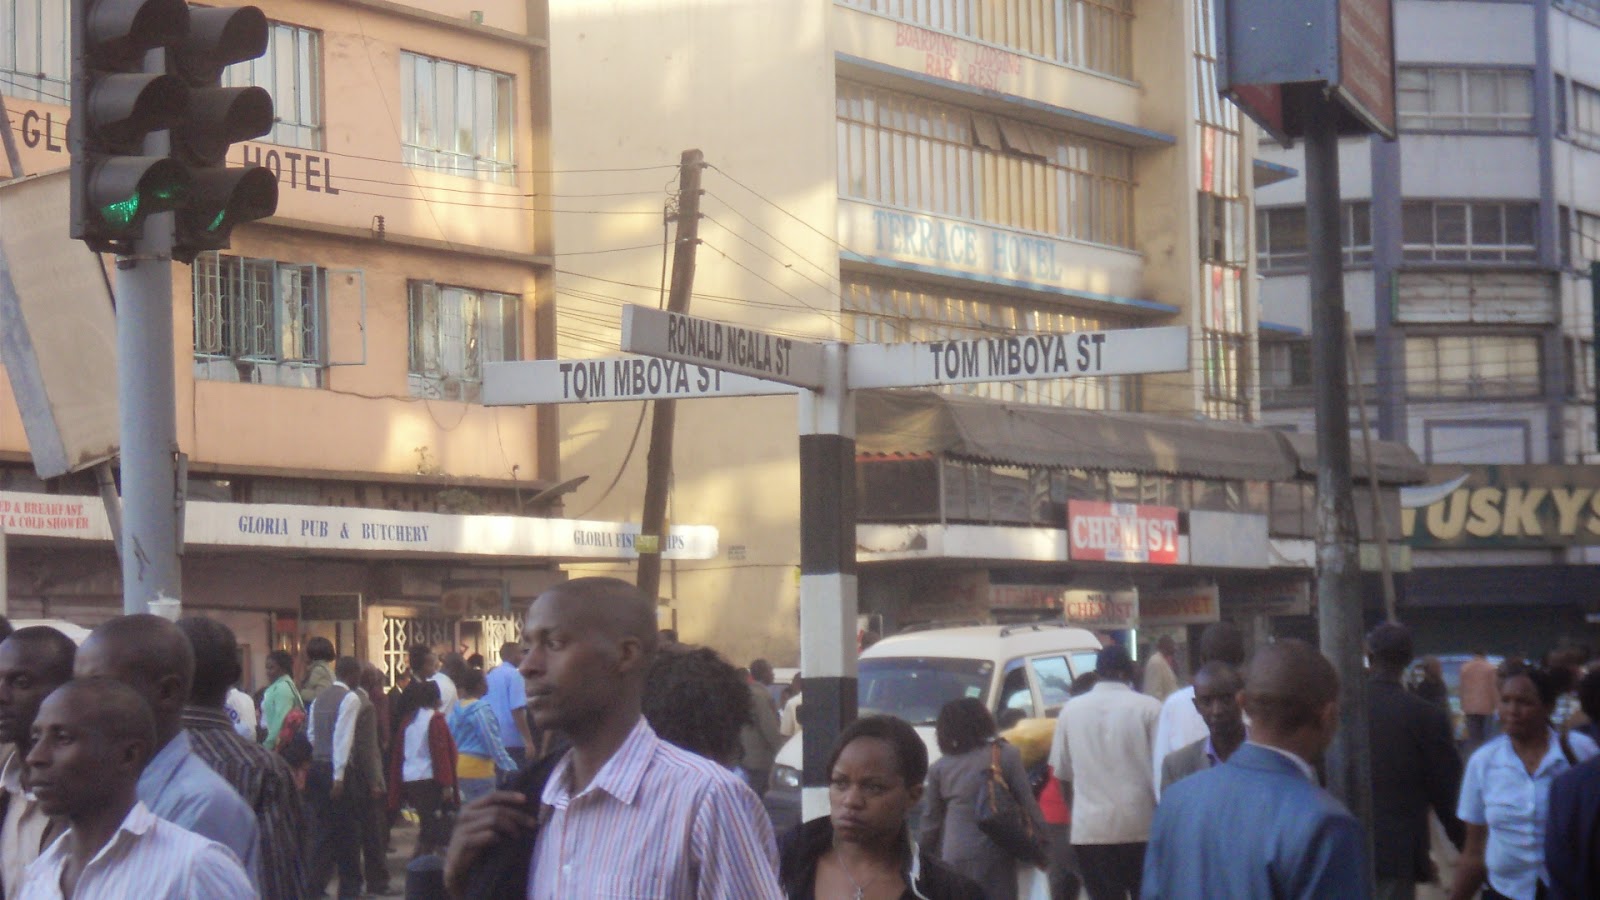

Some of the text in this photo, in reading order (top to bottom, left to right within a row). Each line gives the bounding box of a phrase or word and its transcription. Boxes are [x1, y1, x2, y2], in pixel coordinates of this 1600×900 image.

[925, 52, 954, 80] BAR
[22, 109, 339, 195] GL HOTEL
[872, 210, 1063, 281] TERRACE HOTEL
[667, 313, 792, 376] RONALD NGALA ST
[930, 333, 1106, 380] TOM MBOYA ST
[559, 358, 722, 398] TOM MBOYA ST
[19, 516, 45, 529] COLD
[47, 517, 89, 529] SHOWER
[24, 502, 84, 516] BREAKFAST
[238, 515, 429, 542] GLORIA PUB & BUTCHERY
[573, 529, 613, 548] GLORIA
[1072, 515, 1177, 552] CHEMIST
